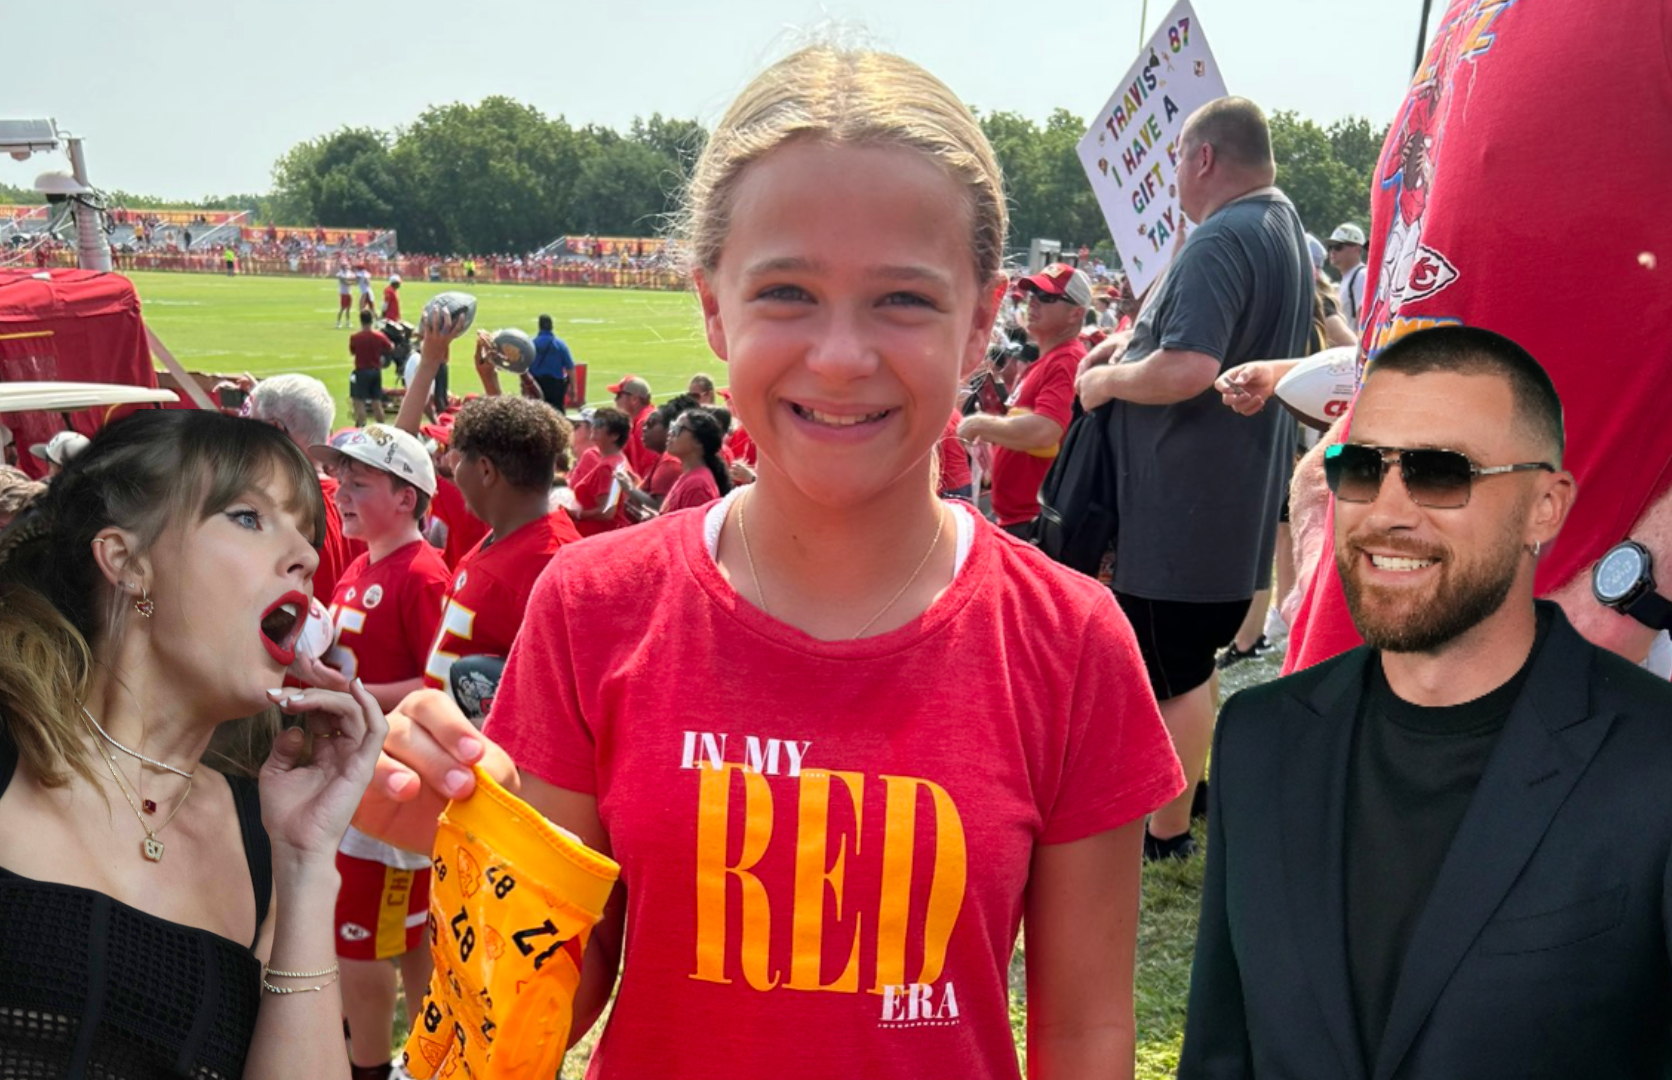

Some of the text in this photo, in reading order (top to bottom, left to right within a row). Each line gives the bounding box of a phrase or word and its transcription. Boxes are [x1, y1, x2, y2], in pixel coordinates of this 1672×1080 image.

[1106, 17, 1190, 141] TRAVIS 87
[1111, 95, 1179, 188] I HAVE A
[1132, 163, 1164, 214] GIFT
[1147, 205, 1175, 252] TAY
[680, 731, 812, 777] IN MY
[688, 760, 967, 996] RED
[451, 905, 475, 963] 87
[878, 981, 960, 1022] ERA
